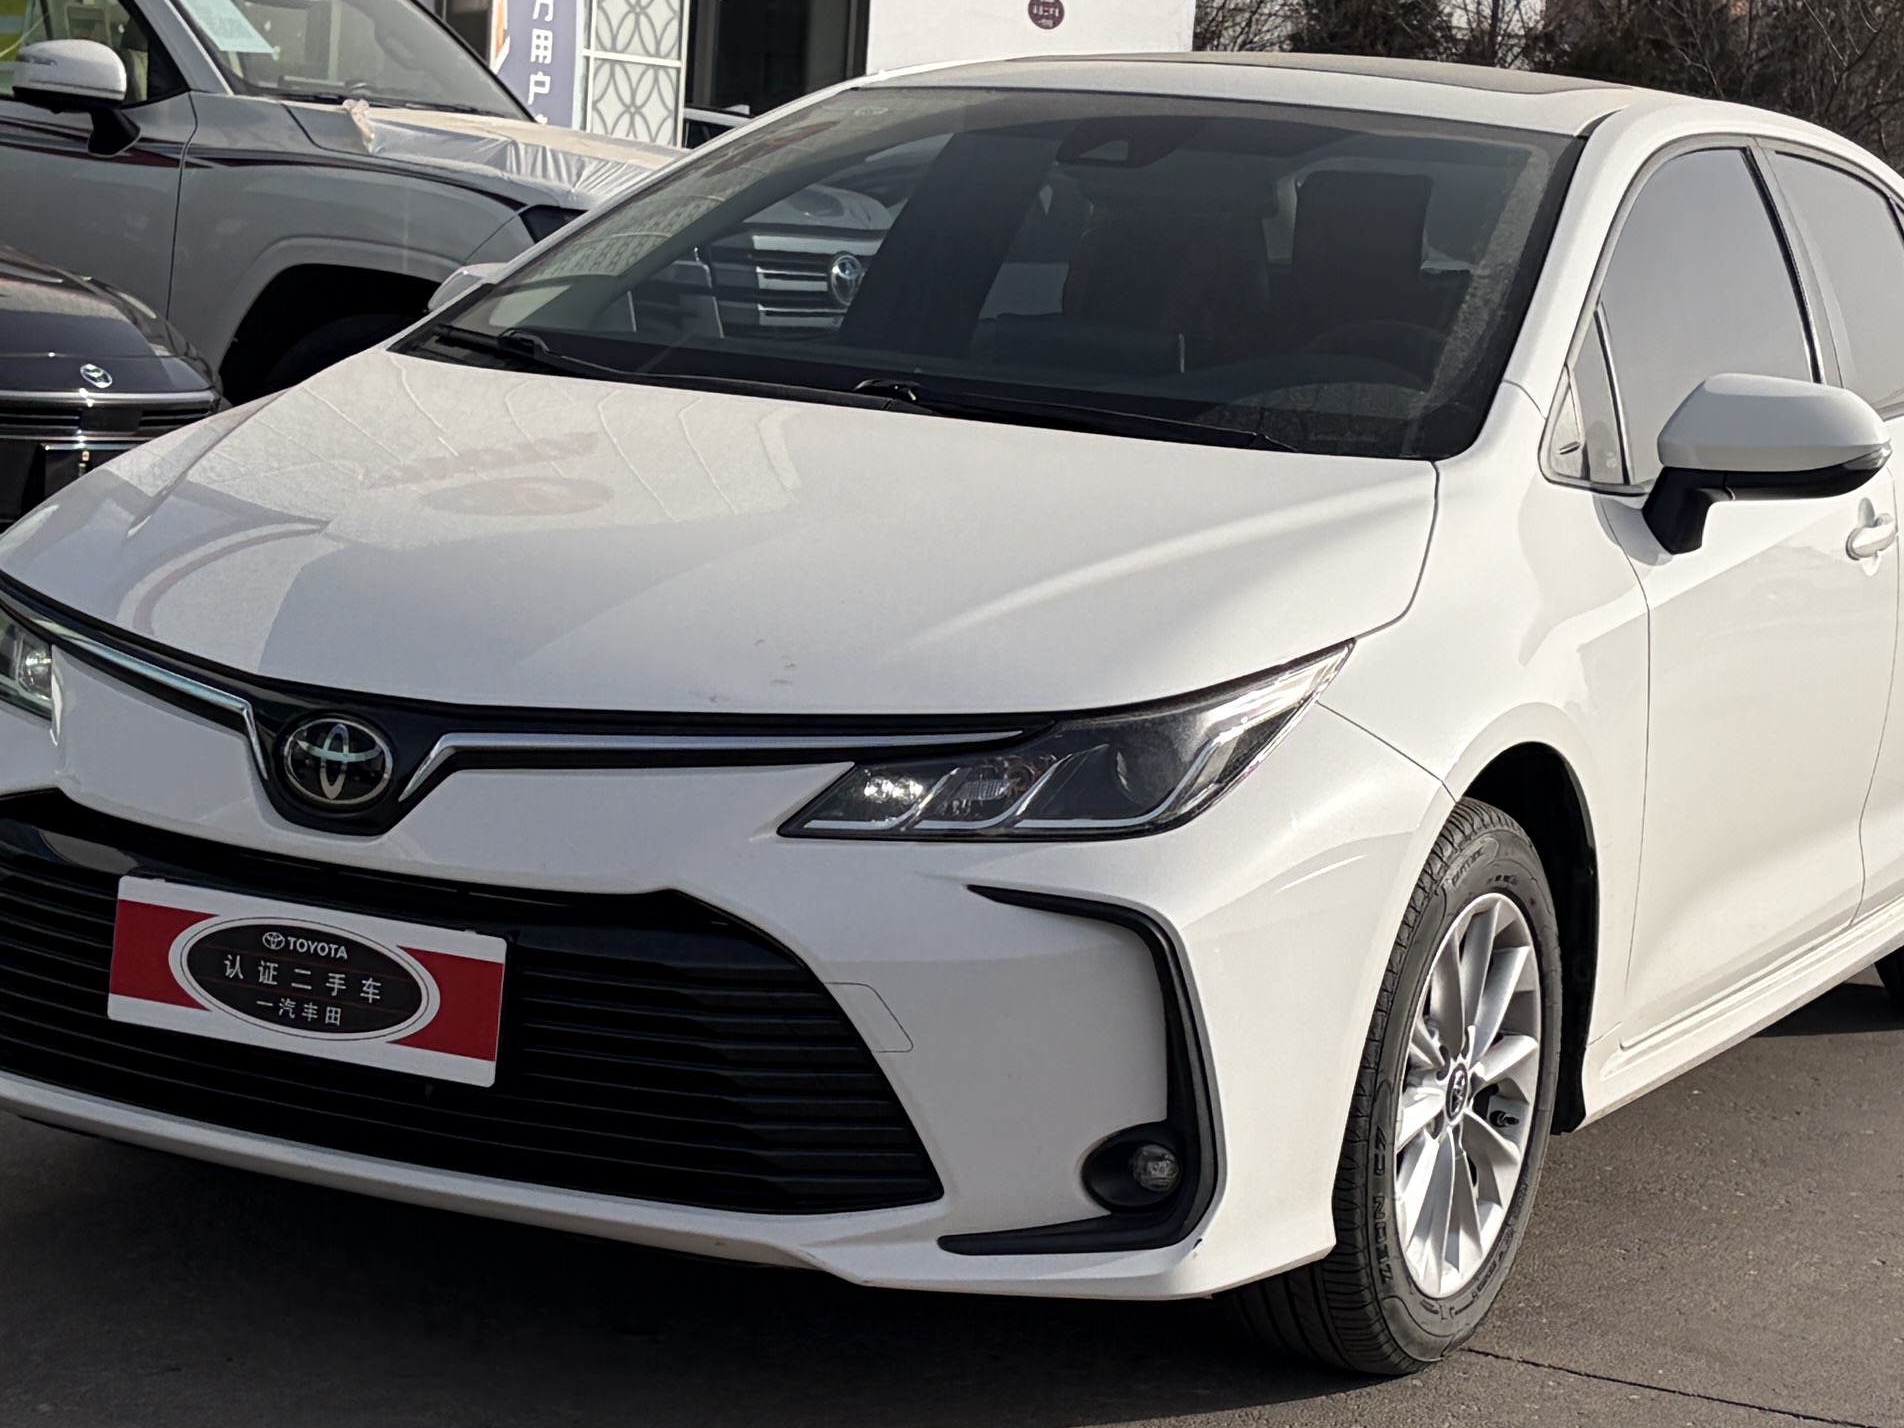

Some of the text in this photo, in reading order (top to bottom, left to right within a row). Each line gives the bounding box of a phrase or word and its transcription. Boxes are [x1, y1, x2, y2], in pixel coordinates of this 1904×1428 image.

[287, 936, 348, 960] TOYOTA
[223, 954, 382, 1004] 认证二手车
[256, 997, 342, 1027] 一汽丰田
